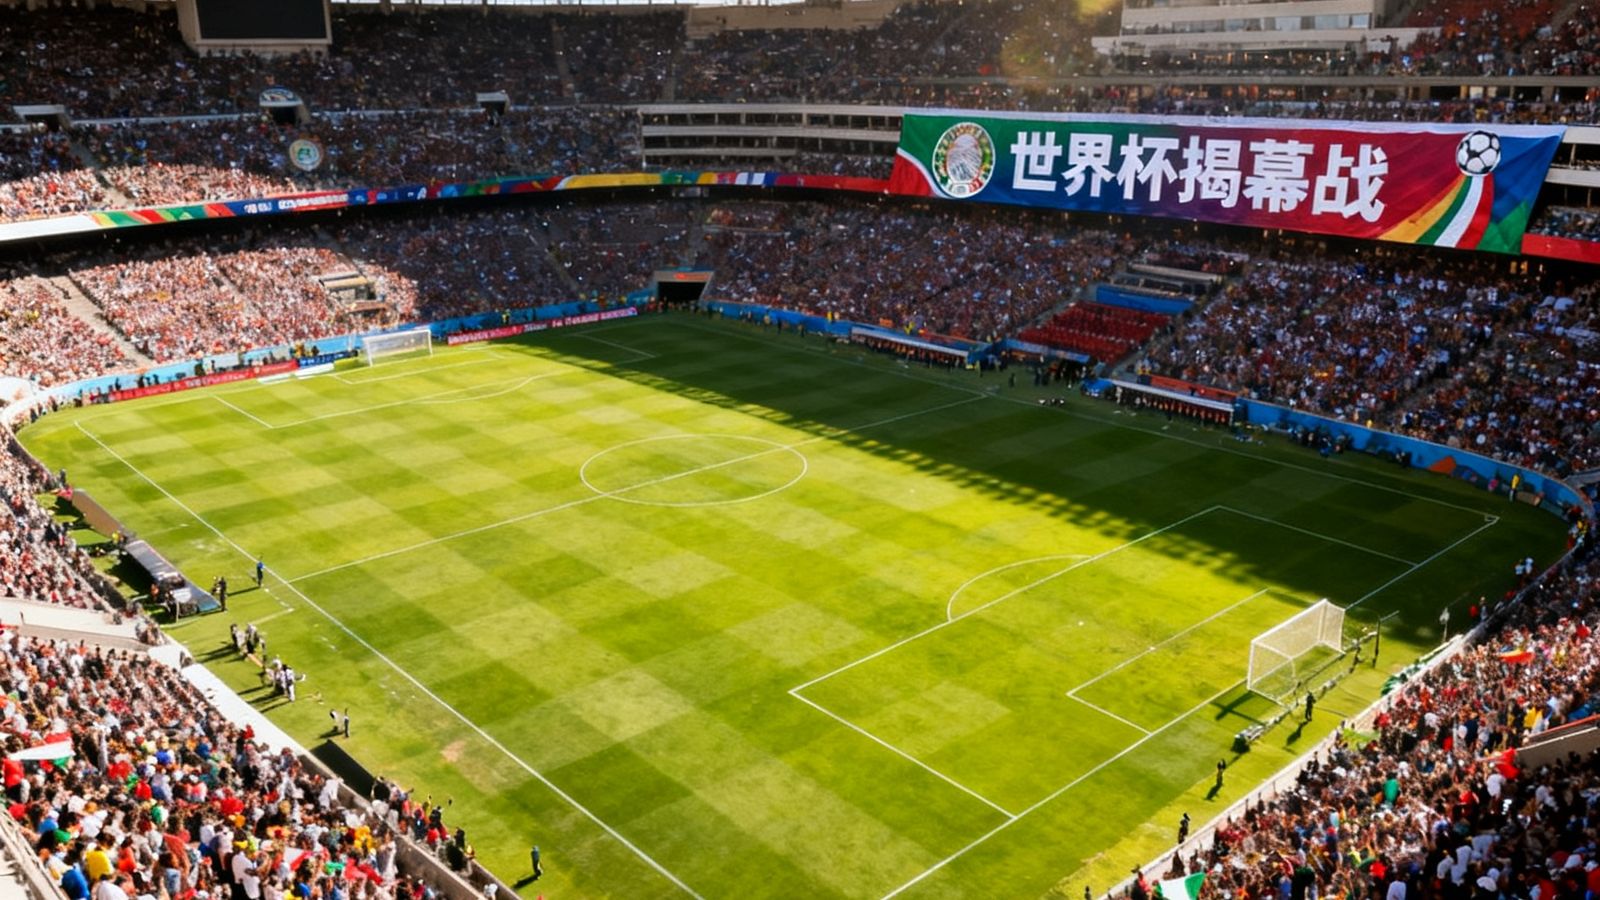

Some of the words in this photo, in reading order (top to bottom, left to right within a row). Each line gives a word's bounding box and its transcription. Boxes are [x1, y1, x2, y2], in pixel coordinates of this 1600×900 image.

[1010, 131, 1388, 222] 世界杯揭幕战
